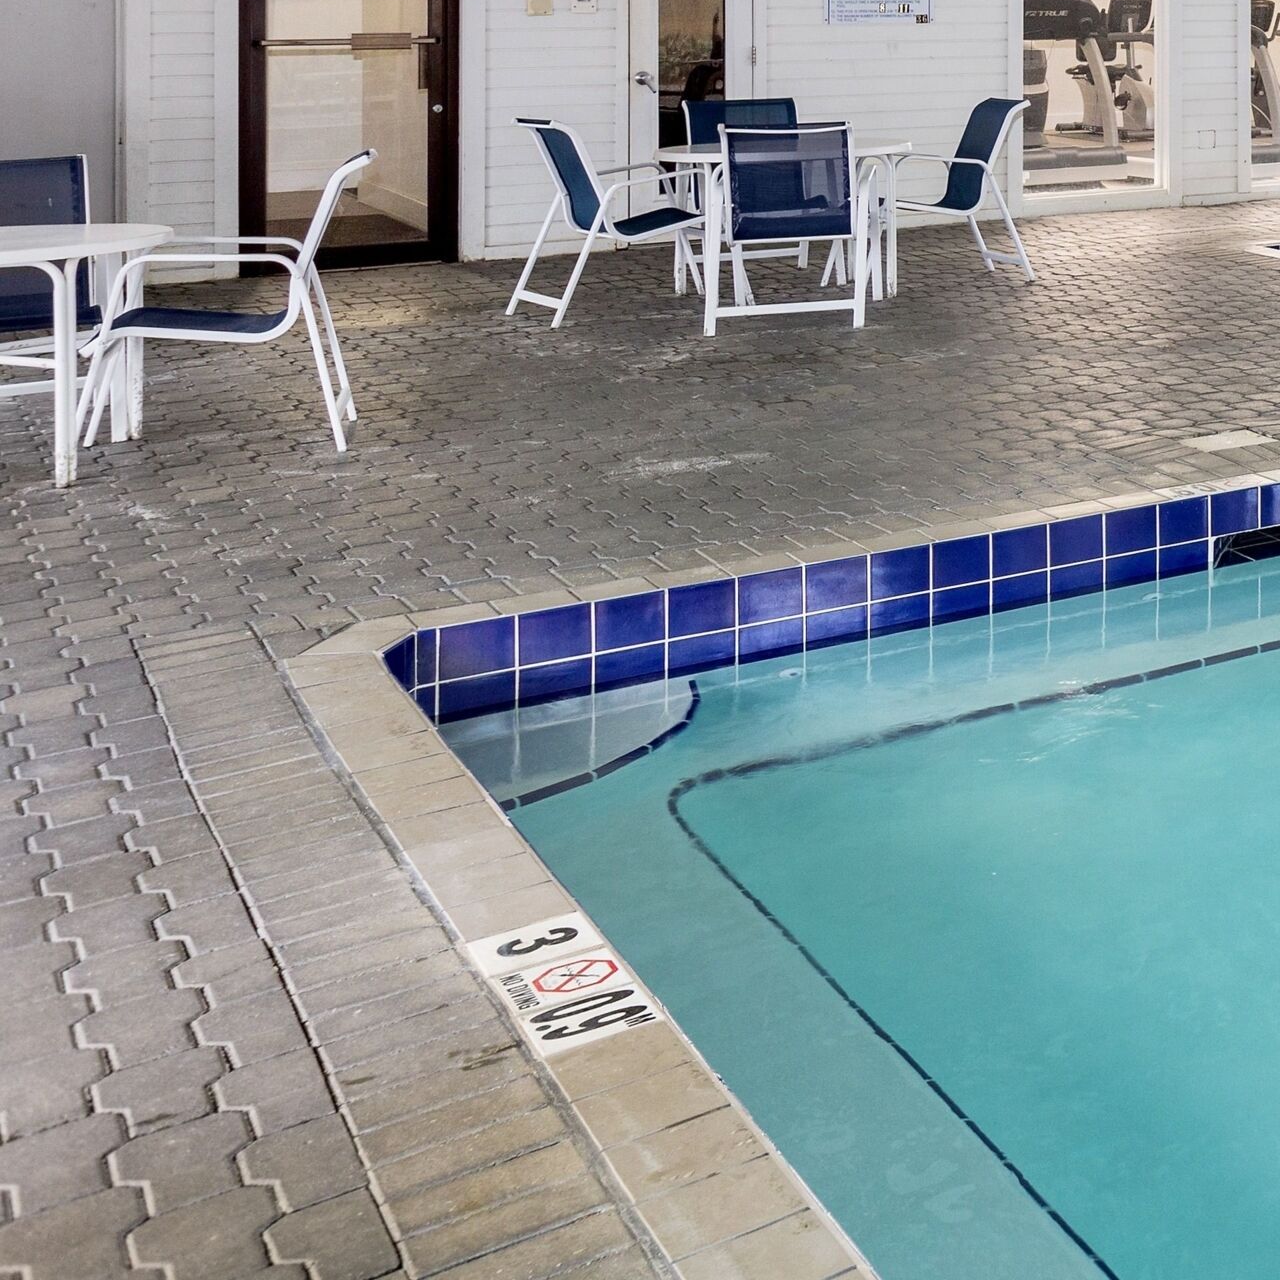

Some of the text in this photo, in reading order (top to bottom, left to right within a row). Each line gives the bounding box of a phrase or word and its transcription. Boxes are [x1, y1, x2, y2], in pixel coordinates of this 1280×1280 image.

[497, 927, 578, 957] 3
[499, 973, 540, 1010] NO DIVING
